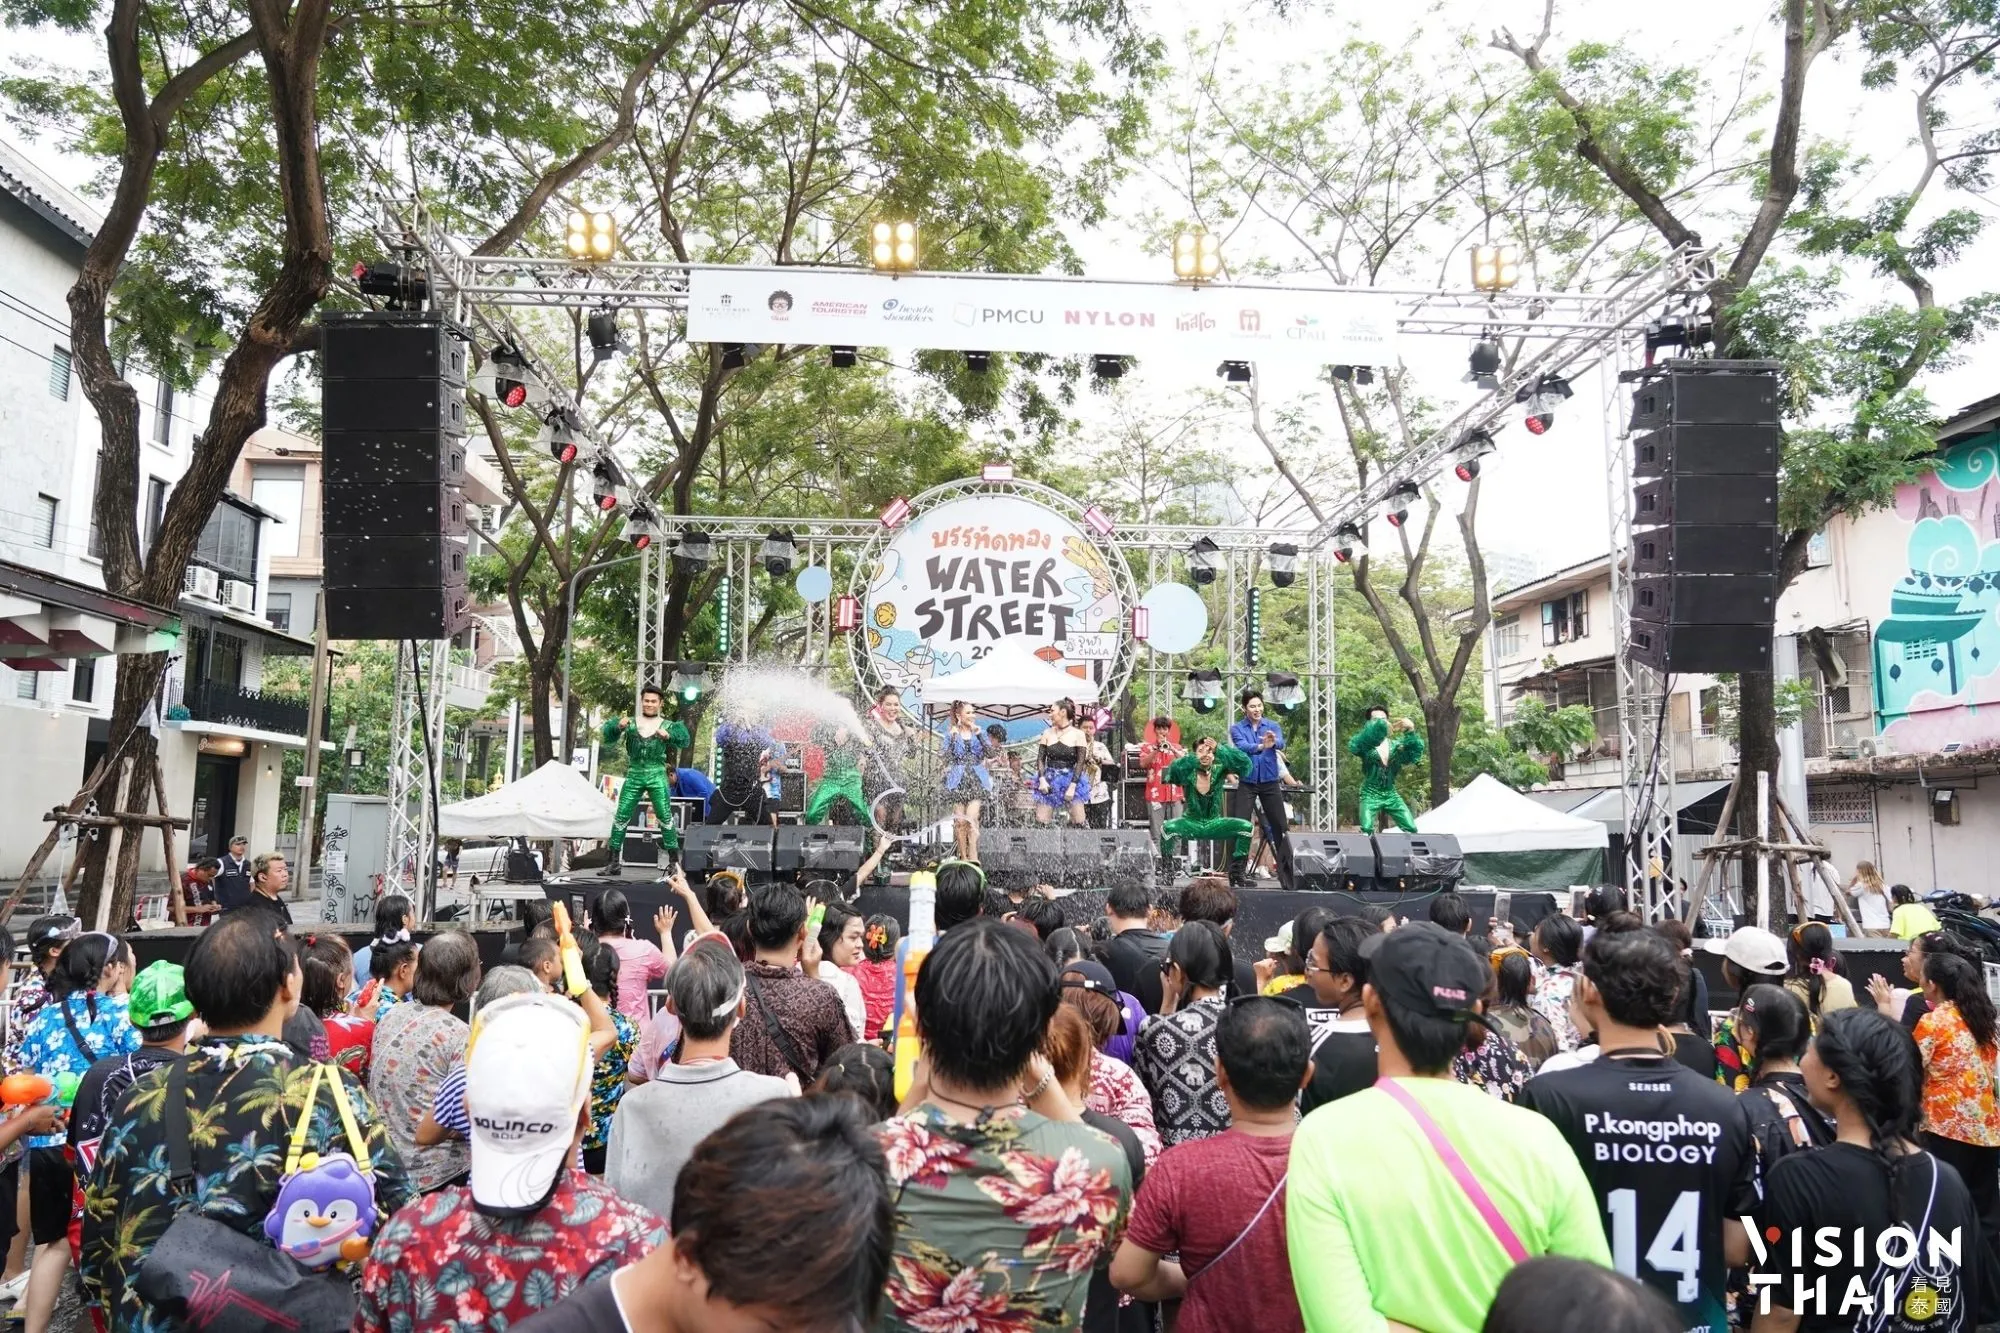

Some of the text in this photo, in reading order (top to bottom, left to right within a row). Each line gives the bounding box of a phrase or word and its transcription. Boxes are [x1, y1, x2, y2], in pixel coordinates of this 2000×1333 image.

[811, 307, 867, 316] TOURISTER
[812, 301, 868, 310] AMERICAN
[982, 309, 1044, 324] PMCU
[1064, 310, 1156, 327] NYLON
[931, 525, 1052, 552] บรรทัดทอง
[925, 555, 1063, 599] WATER
[914, 594, 1075, 641] STREET
[1078, 648, 1109, 656] CHULA
[1628, 1082, 1672, 1092] SENSEI
[1584, 1111, 1721, 1144] P.kongphop
[1594, 1143, 1717, 1164] BIOLOGY
[1607, 1188, 1701, 1303] 14
